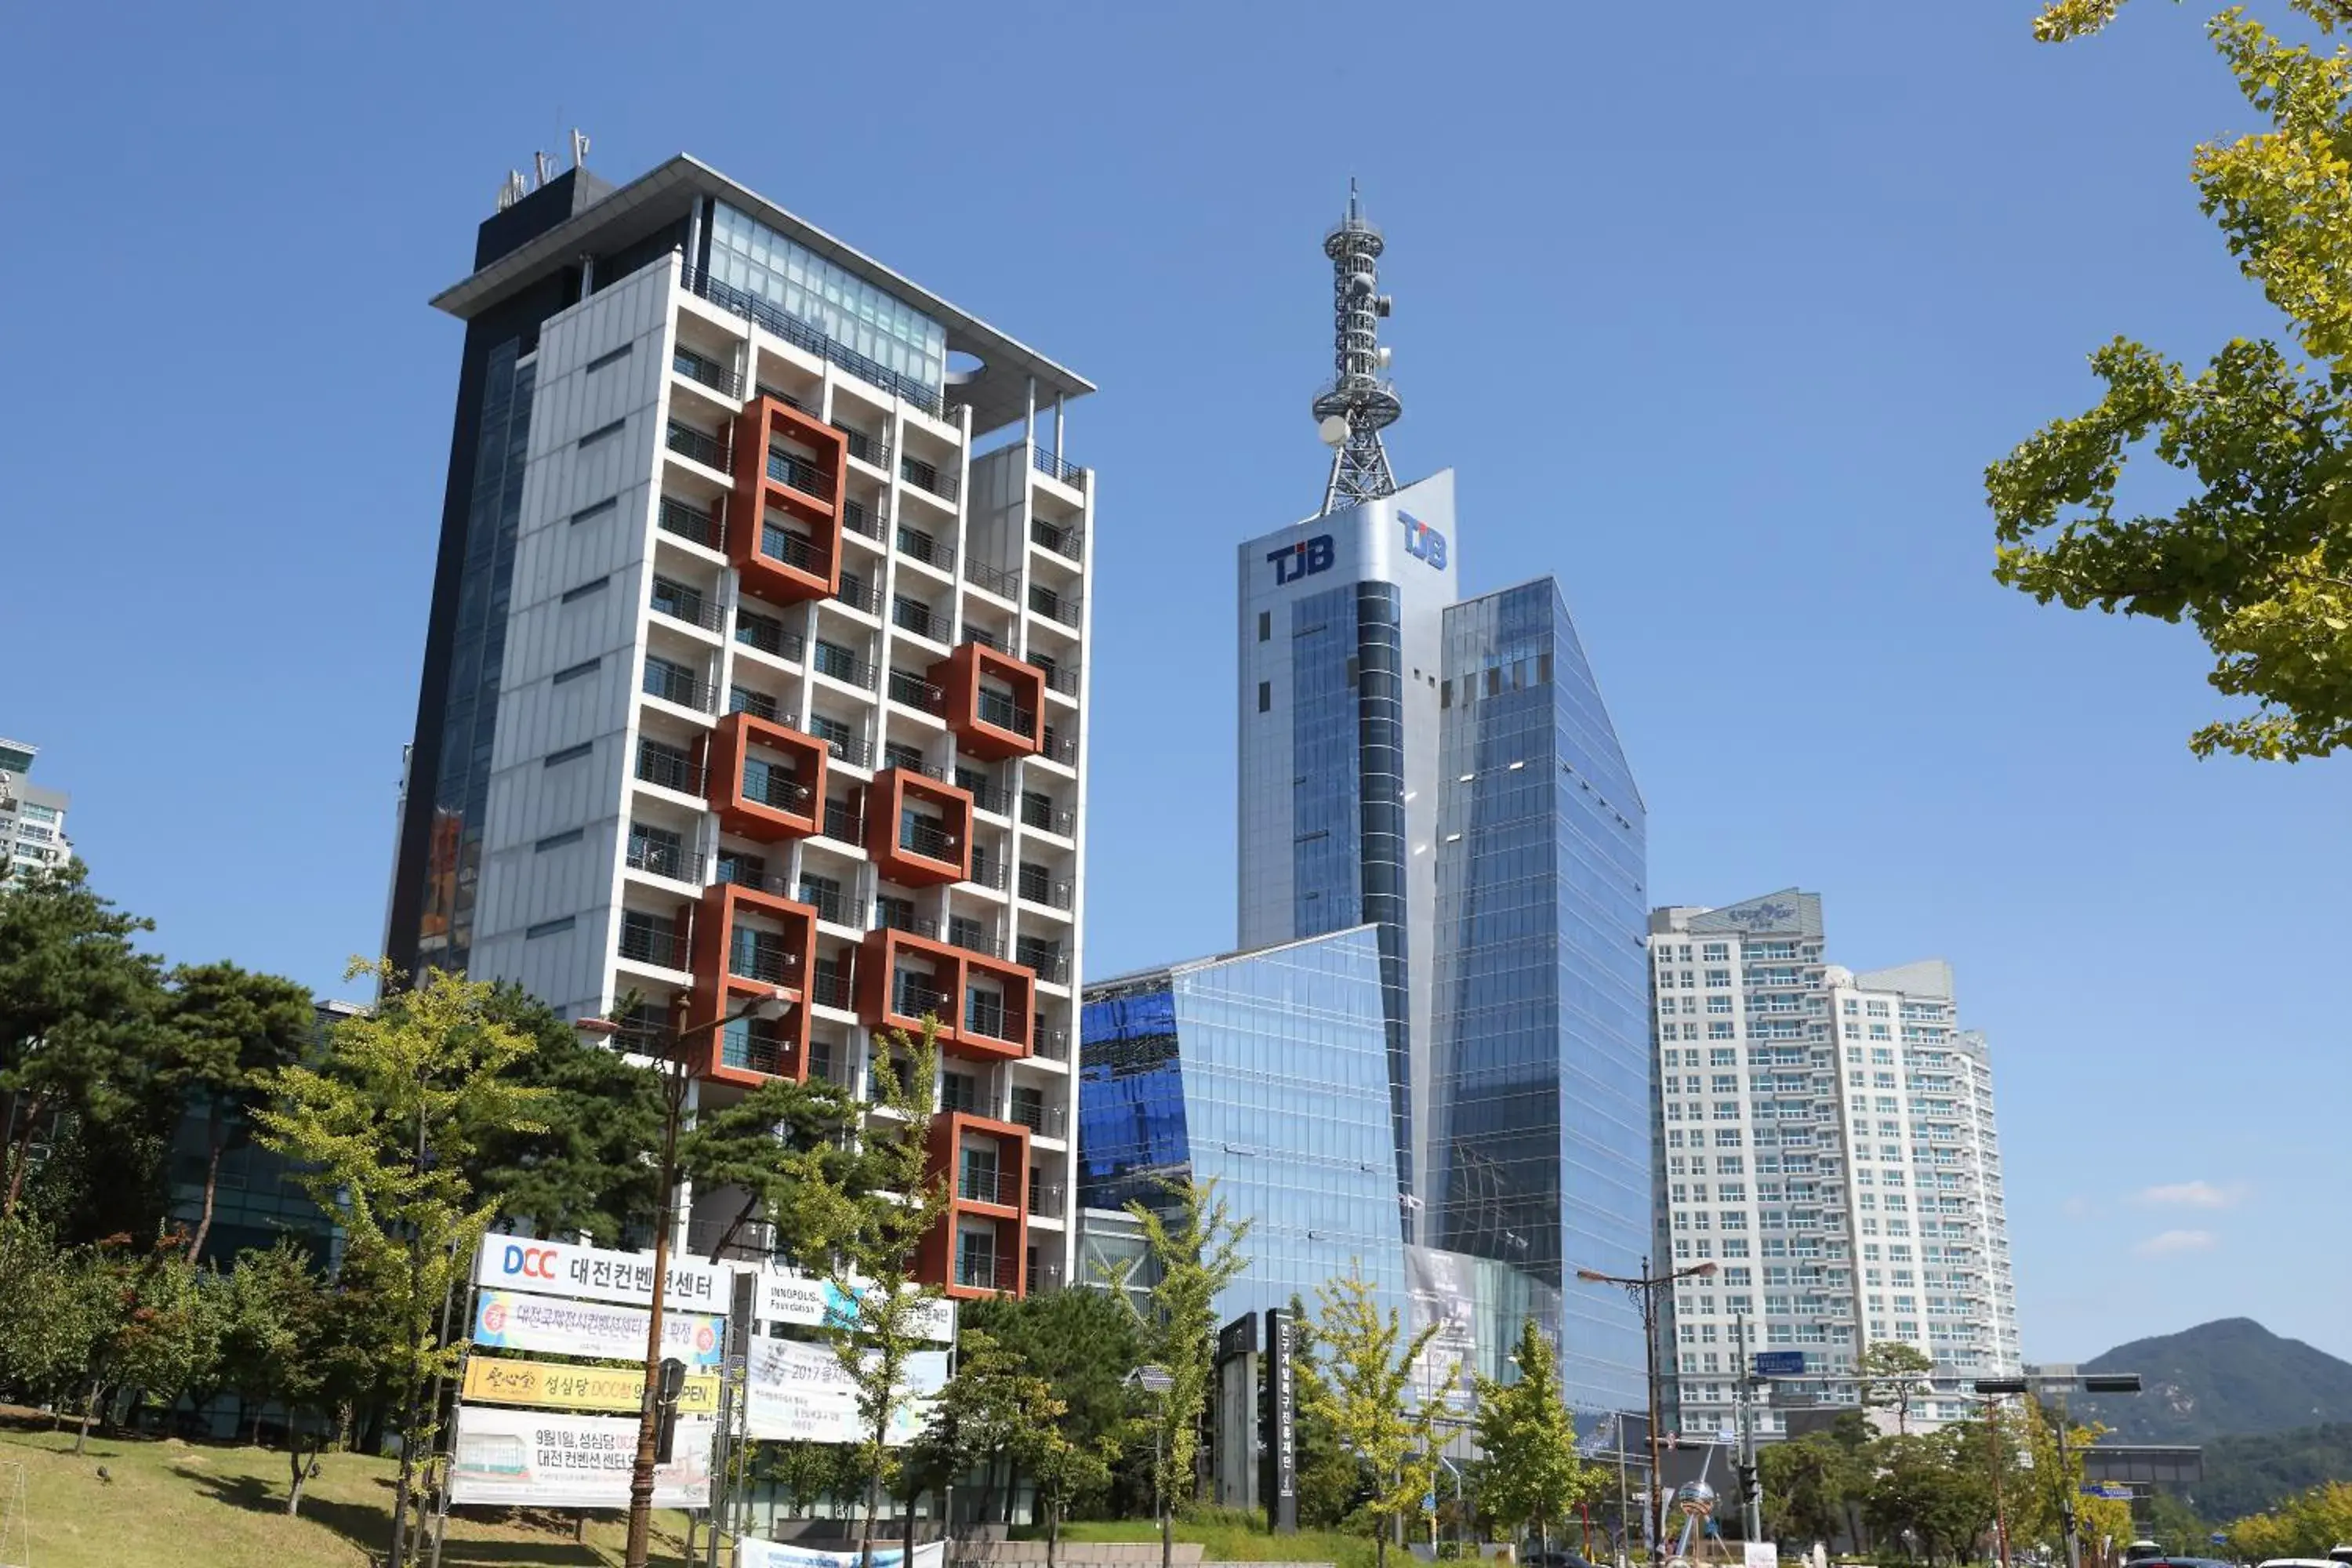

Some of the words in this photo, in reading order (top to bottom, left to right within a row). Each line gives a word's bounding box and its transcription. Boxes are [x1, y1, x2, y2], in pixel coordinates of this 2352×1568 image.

[1397, 510, 1447, 571] TJB
[1267, 534, 1335, 586] TJB
[504, 1245, 557, 1279] DCC
[771, 1287, 816, 1301] INNOPOLIS
[771, 1299, 815, 1314] Foundation
[791, 1364, 819, 1381] 2017
[546, 1375, 589, 1396] 성심당
[579, 1432, 615, 1450] 성심당
